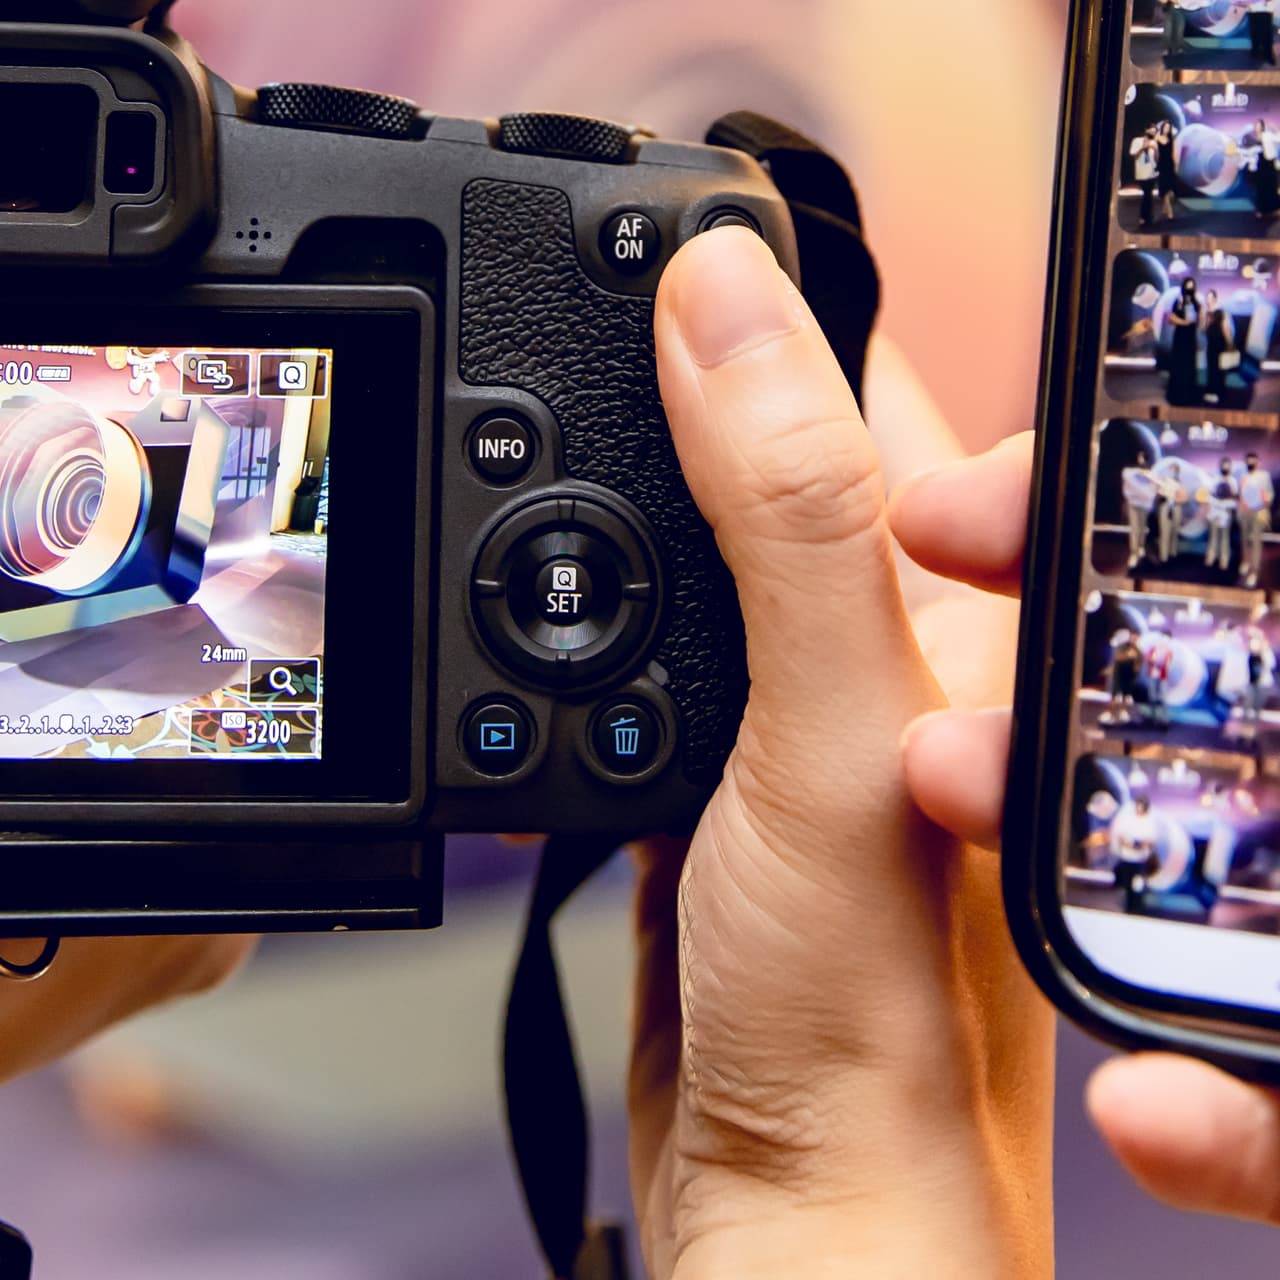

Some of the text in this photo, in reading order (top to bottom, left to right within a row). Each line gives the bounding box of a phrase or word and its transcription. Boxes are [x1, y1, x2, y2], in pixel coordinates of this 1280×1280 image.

[616, 218, 643, 237] AF
[615, 239, 644, 259] ON
[478, 438, 526, 459] INFO
[546, 592, 583, 613] SET
[201, 644, 247, 662] 24mm
[224, 714, 243, 726] ISO
[246, 719, 291, 744] 3200
